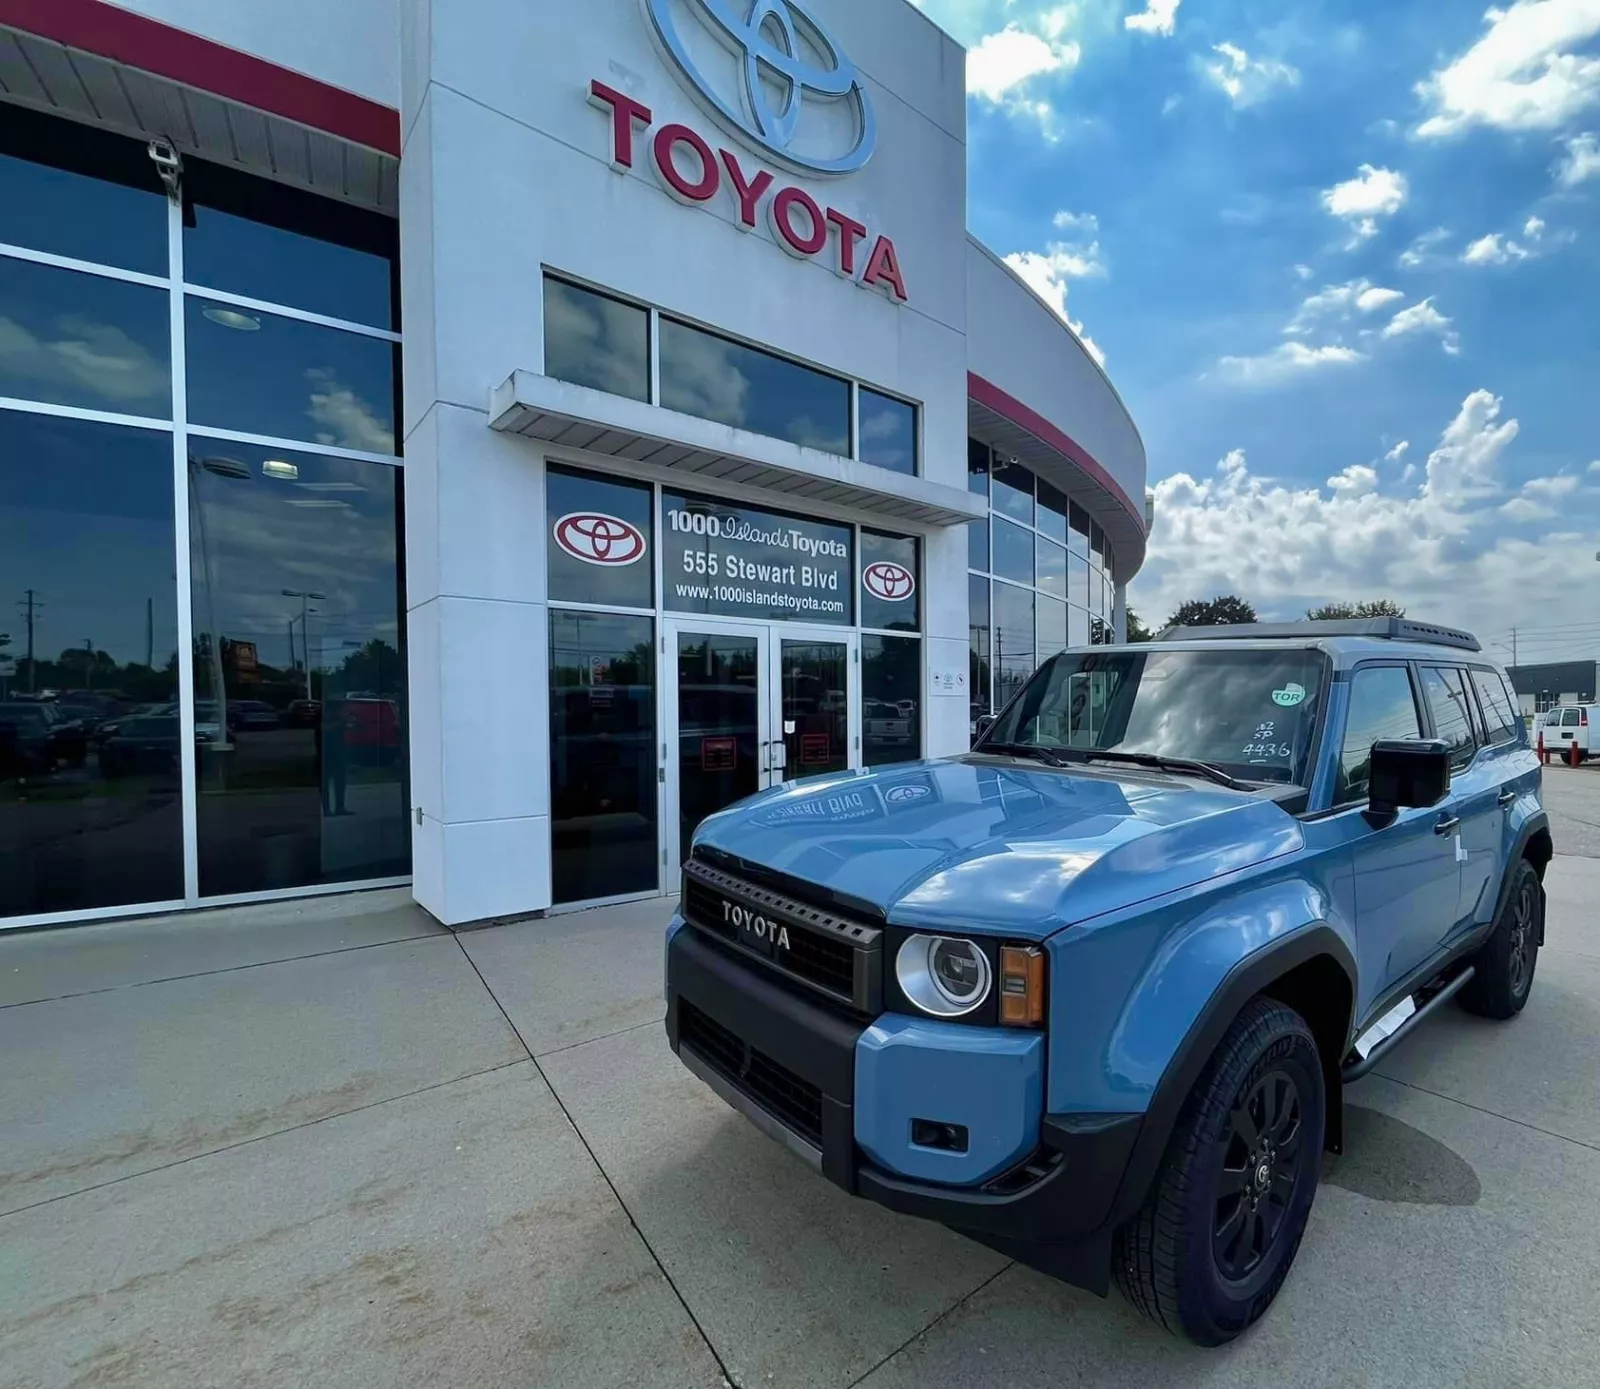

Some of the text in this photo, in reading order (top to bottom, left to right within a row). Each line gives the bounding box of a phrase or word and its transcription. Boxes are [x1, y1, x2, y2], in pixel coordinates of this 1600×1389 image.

[587, 79, 908, 304] TOYOTA
[667, 509, 719, 537] 1000
[788, 529, 847, 558] Toyota
[683, 549, 838, 591] 555 Stewart Blvd
[675, 584, 844, 613] www.1000islandstoyota.com
[1273, 691, 1301, 702] TOR
[1242, 742, 1291, 757] 4436
[722, 900, 791, 950] TOYOTA
